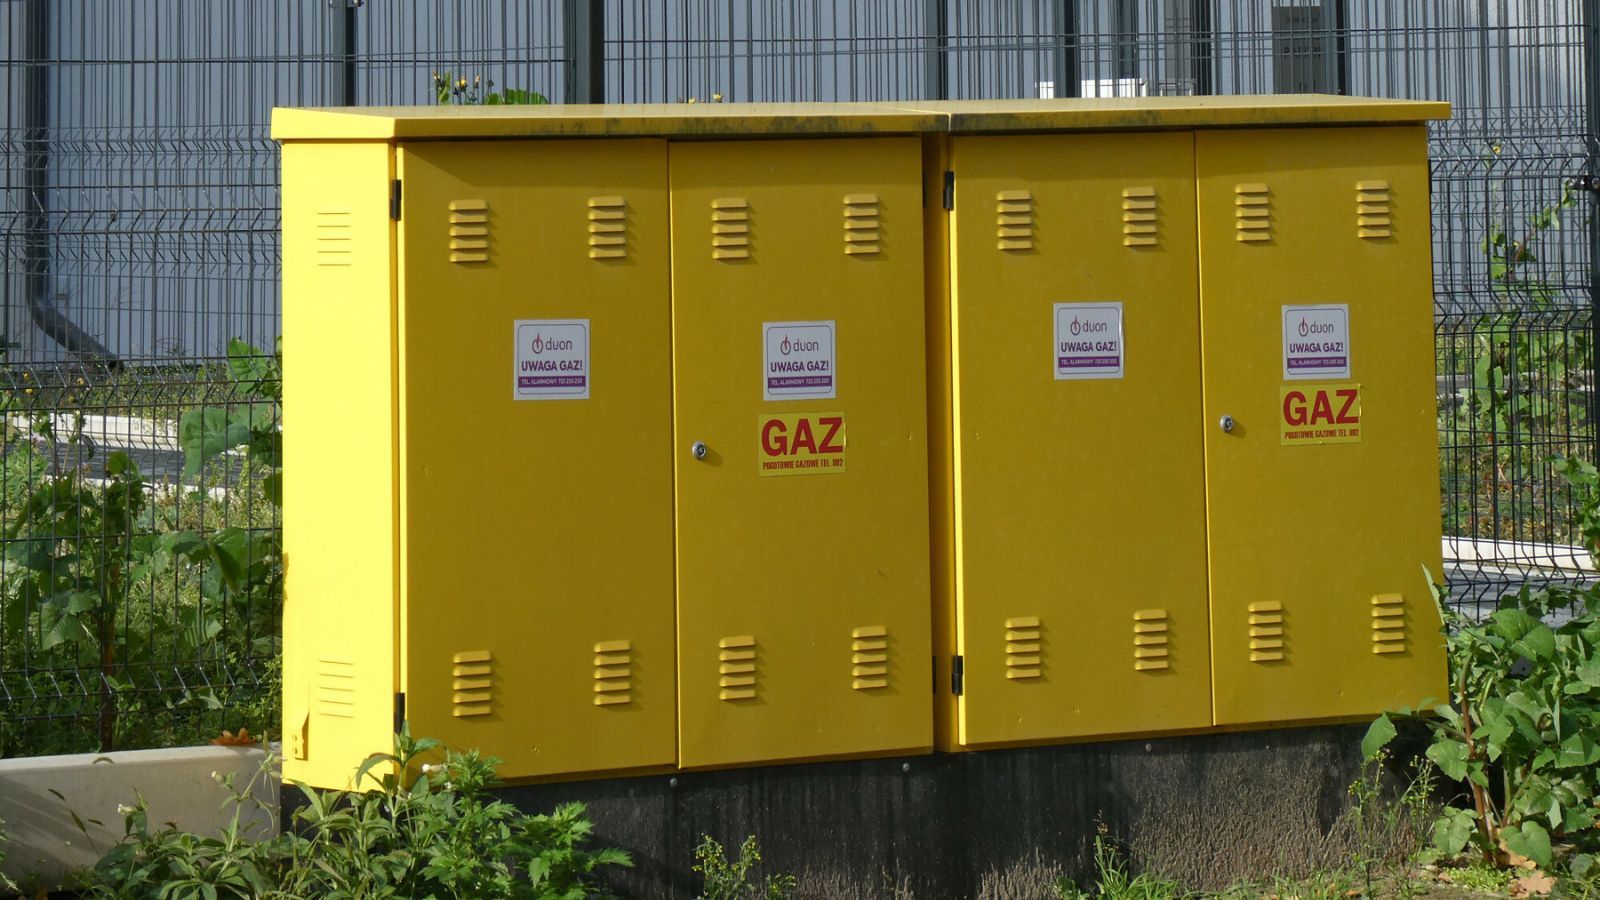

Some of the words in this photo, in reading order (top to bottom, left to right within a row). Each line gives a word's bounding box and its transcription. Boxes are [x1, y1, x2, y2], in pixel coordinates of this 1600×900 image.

[1083, 320, 1107, 332] duon
[1310, 322, 1334, 333] duon
[545, 337, 572, 350] duon
[793, 339, 819, 351] duon
[1061, 342, 1093, 352] UWAGA
[1096, 341, 1117, 351] GAZ!
[1290, 343, 1320, 352] UWAGA
[1323, 342, 1344, 351] GAZ!
[522, 361, 557, 371] UWAGA
[560, 360, 583, 370] GAZ!
[771, 362, 804, 372] UWAGA
[807, 360, 829, 370] GAZ!
[1284, 390, 1358, 425] GAZ
[762, 418, 843, 456] GAZ
